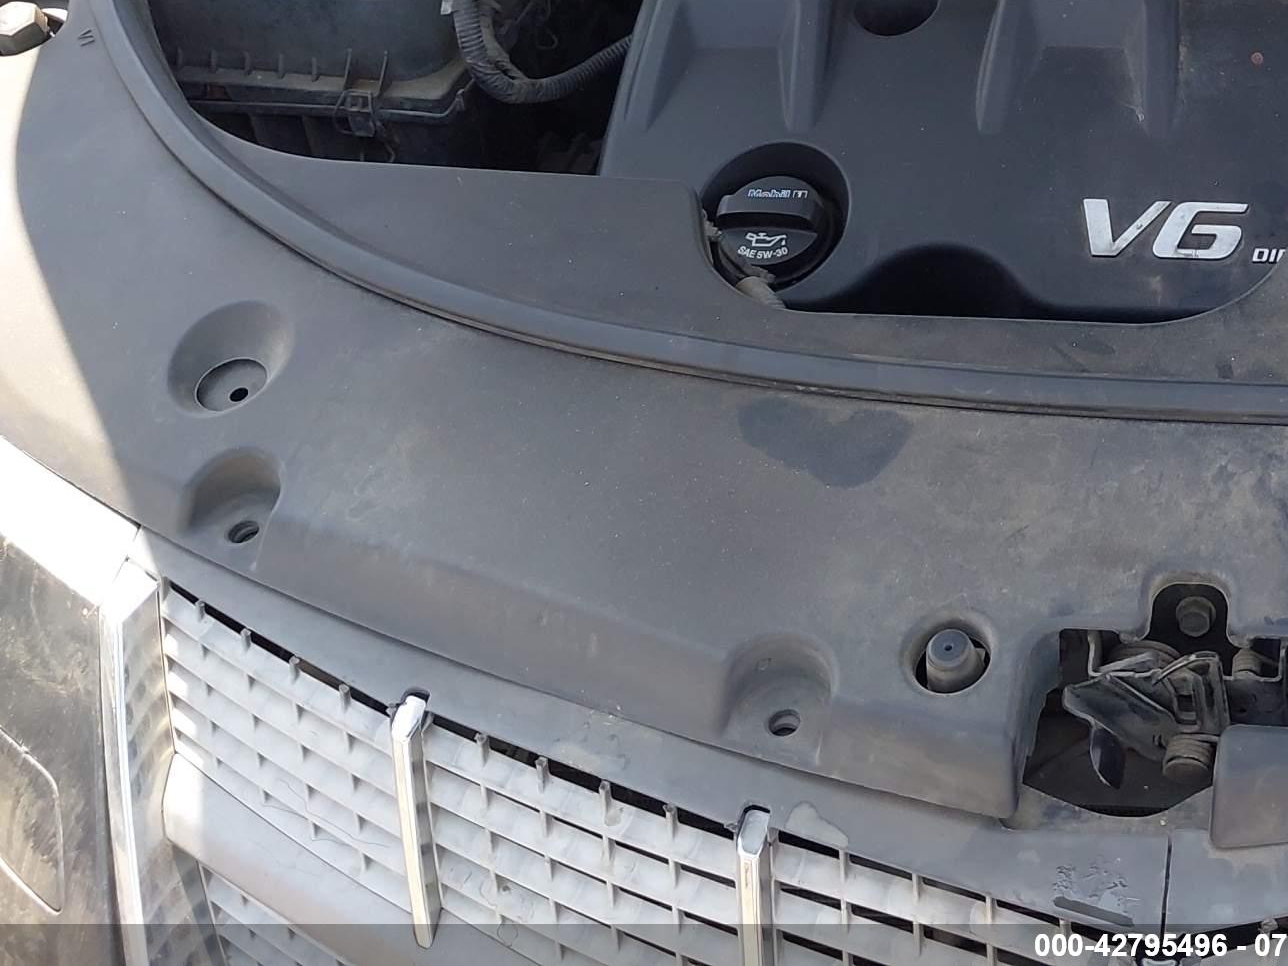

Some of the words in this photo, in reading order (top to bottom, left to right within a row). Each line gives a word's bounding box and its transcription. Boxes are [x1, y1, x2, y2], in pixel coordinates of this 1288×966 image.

[1083, 198, 1249, 261] V6
[738, 245, 757, 258] SAE
[756, 247, 788, 259] 5W-30
